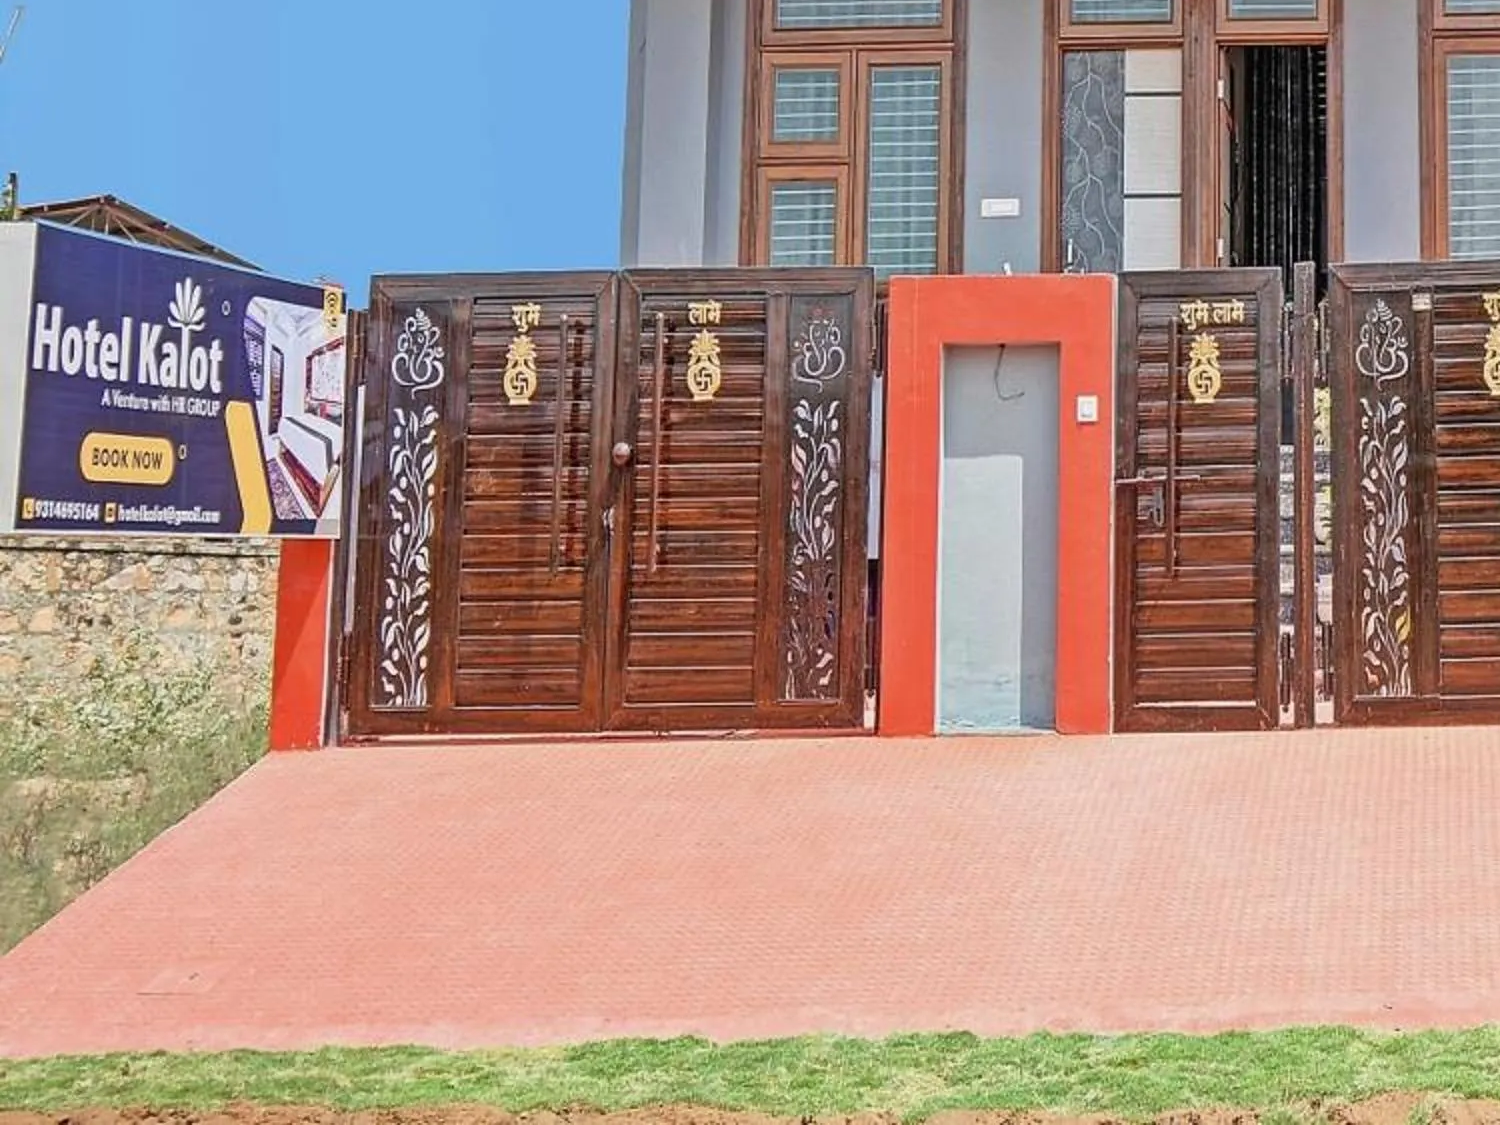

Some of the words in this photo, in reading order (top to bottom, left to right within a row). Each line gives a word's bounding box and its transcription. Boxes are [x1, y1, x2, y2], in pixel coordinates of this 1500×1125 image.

[32, 302, 133, 382] Hotel
[138, 320, 224, 394] Kalot
[101, 388, 111, 406] A
[111, 389, 150, 411] Venture
[150, 394, 170, 412] with
[187, 398, 221, 417] GROUP
[92, 447, 129, 469] BOOK
[131, 450, 163, 470] NOW
